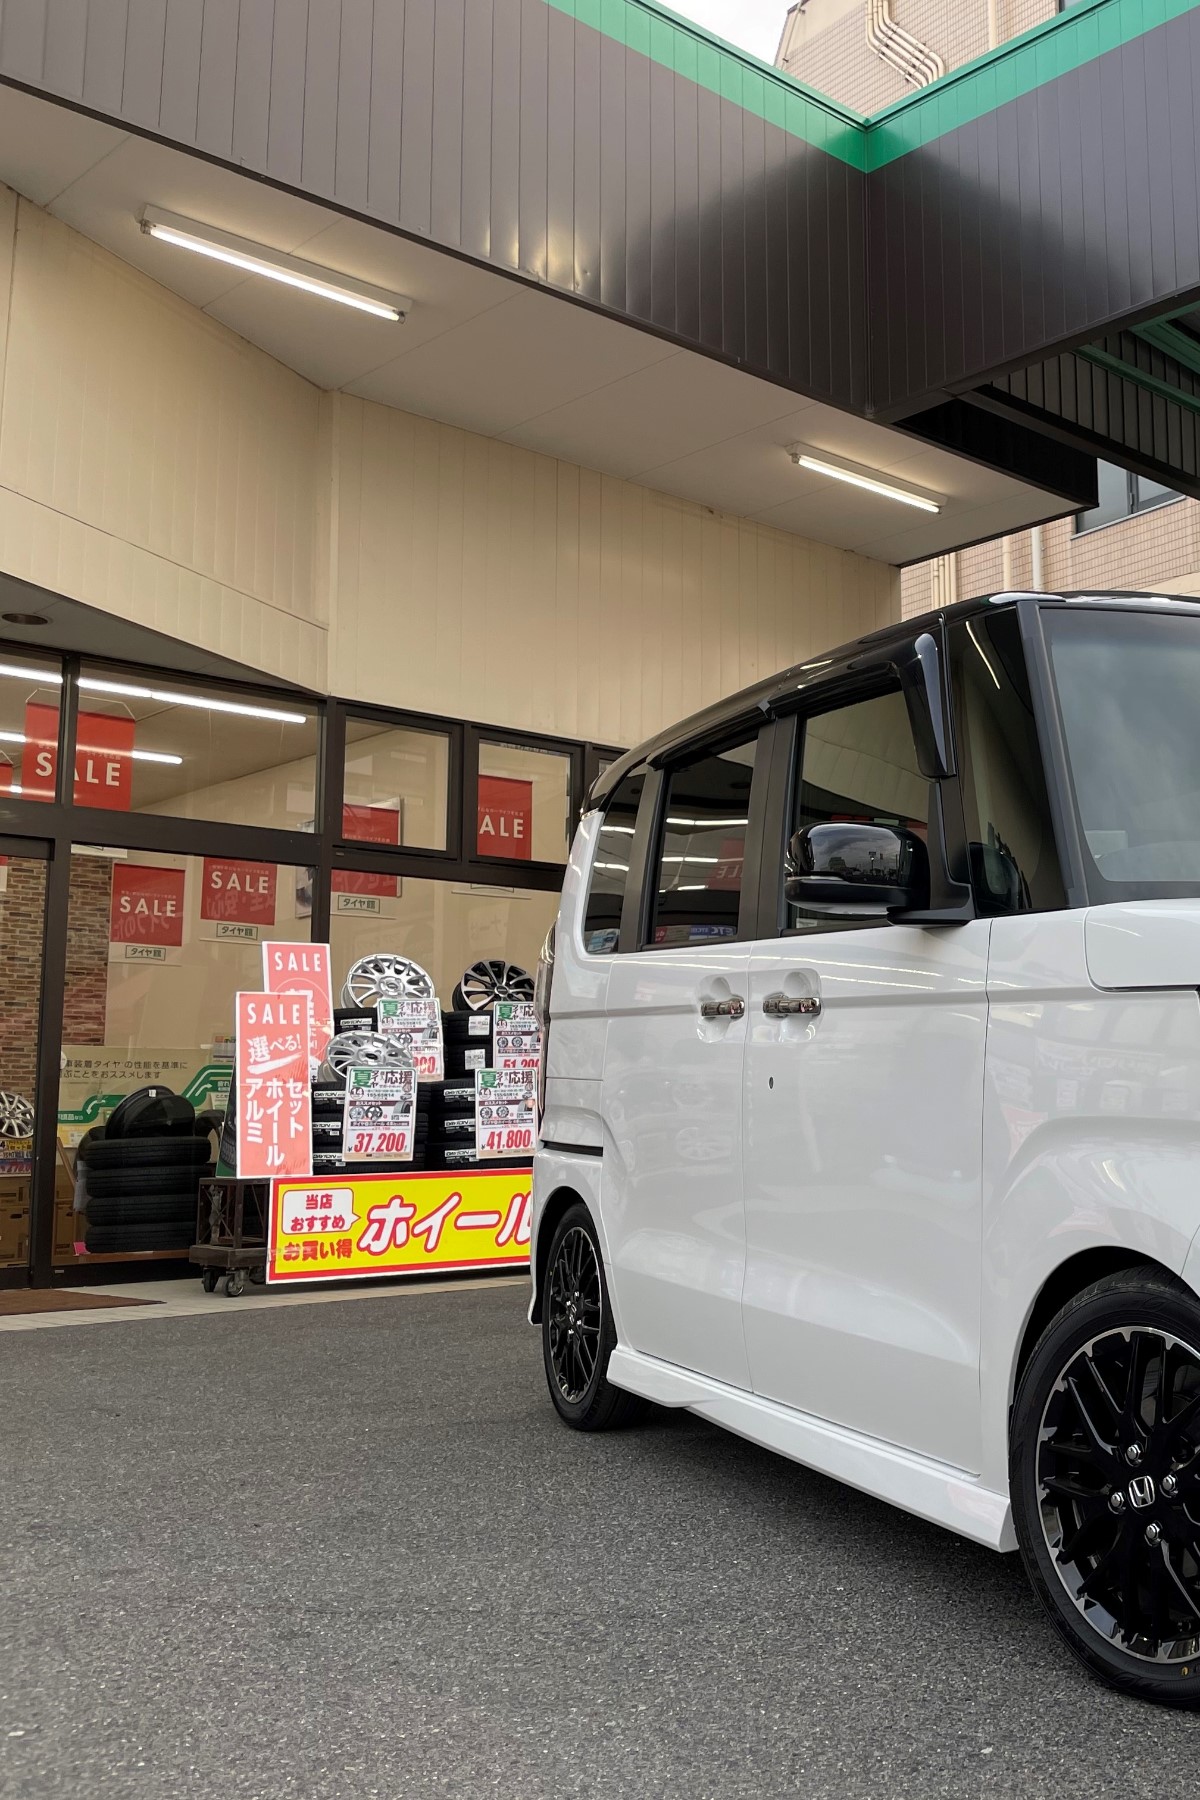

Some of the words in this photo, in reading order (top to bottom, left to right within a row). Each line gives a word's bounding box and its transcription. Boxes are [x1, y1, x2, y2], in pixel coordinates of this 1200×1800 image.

[35, 752, 121, 787] SLE
[478, 815, 524, 839] ALE
[211, 871, 269, 894] SALE
[119, 896, 177, 917] SALE
[343, 899, 376, 910] タイヤ館
[220, 926, 253, 937] タイヤ館
[130, 947, 162, 958] タイヤ館
[274, 952, 321, 972] SALE
[247, 1003, 300, 1025] SALE
[247, 1033, 301, 1062] 選べる!
[246, 1078, 264, 1143] アルミ
[286, 1078, 304, 1139] セット
[266, 1077, 285, 1167] ホイール
[354, 1132, 406, 1153] 37,200
[487, 1129, 531, 1149] 41,800
[305, 1193, 333, 1211] 当店
[291, 1215, 346, 1232] おすすめ
[357, 1191, 532, 1257] ホイール
[283, 1238, 353, 1262] お買い得
